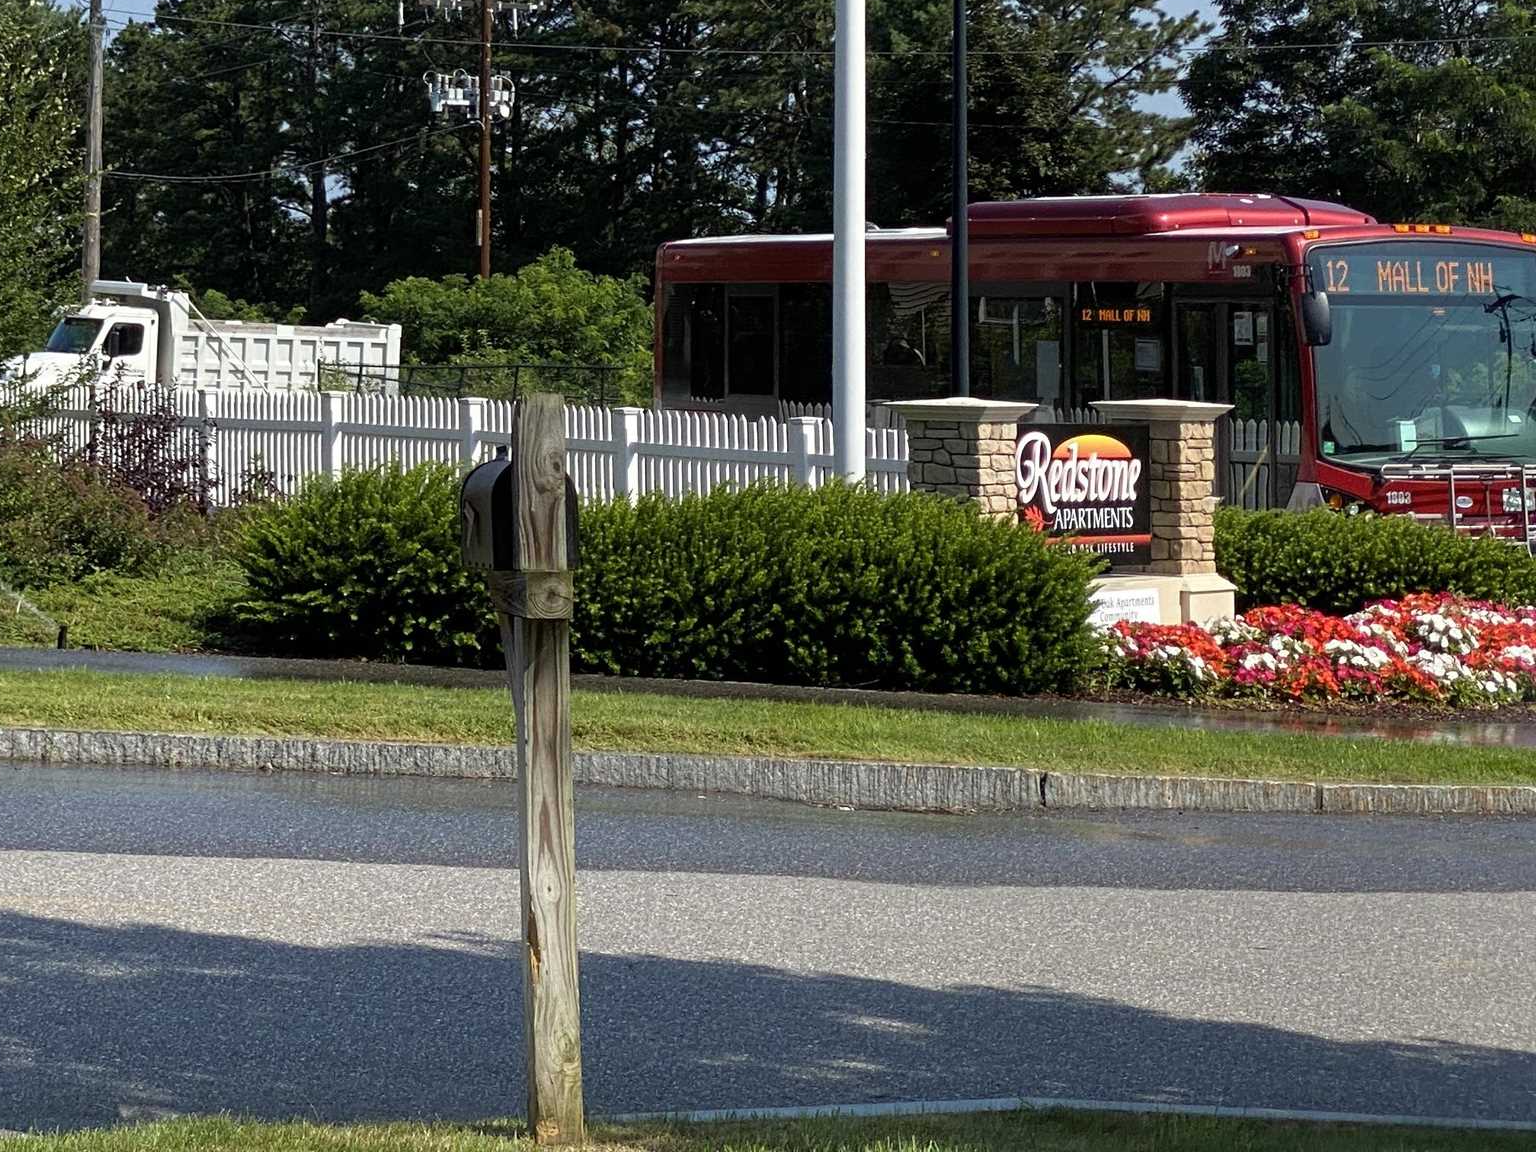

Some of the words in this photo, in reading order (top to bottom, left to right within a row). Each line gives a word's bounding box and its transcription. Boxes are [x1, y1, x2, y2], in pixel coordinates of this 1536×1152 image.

[1326, 260, 1350, 293] 12
[1376, 260, 1430, 293] MALL
[1435, 261, 1459, 293] OF
[1466, 261, 1495, 294] NH
[1081, 308, 1093, 321] 12
[1098, 308, 1121, 322] MALL
[1123, 308, 1136, 322] OF
[1136, 308, 1151, 322] NH
[1015, 431, 1142, 514] Redstone
[1053, 506, 1134, 530] APARTMENTS
[1097, 542, 1135, 554] LIFESTYLE
[1116, 596, 1155, 610] Apartments
